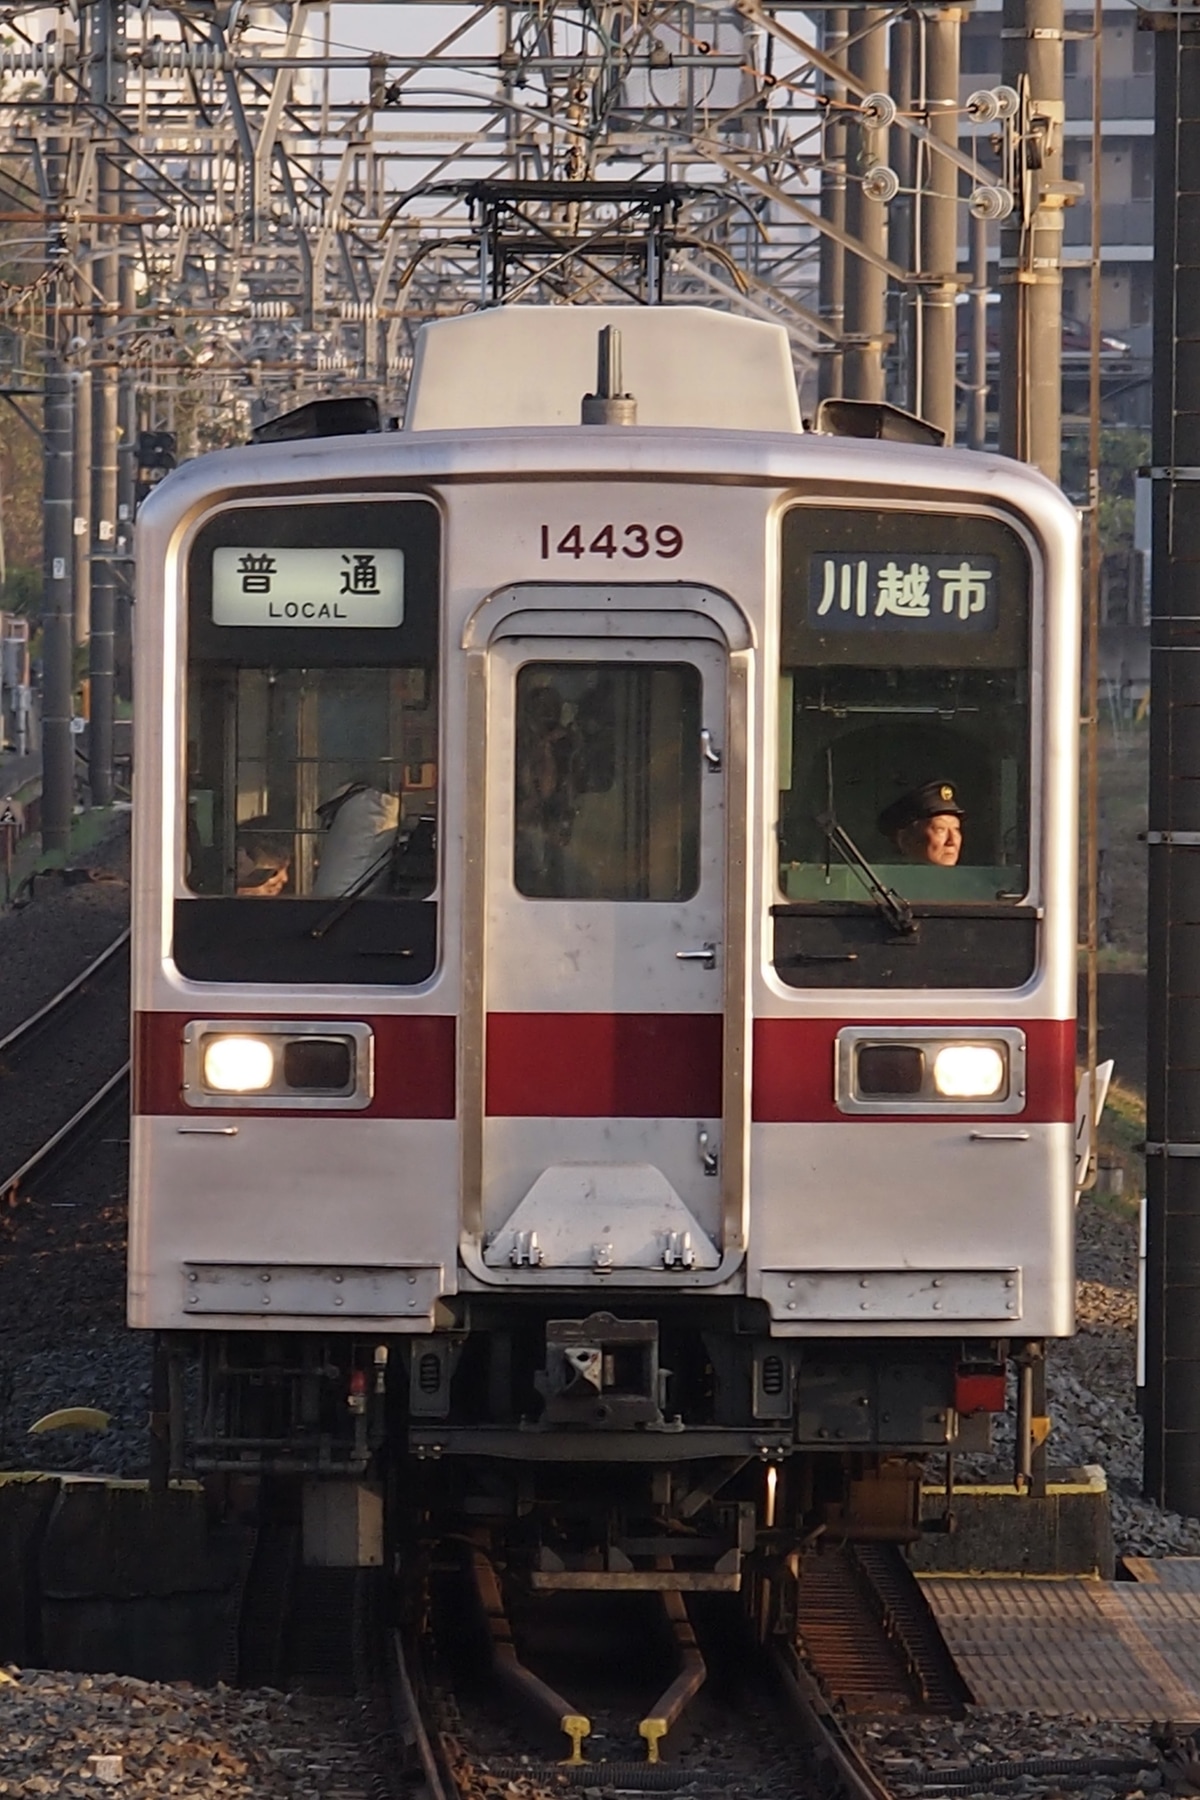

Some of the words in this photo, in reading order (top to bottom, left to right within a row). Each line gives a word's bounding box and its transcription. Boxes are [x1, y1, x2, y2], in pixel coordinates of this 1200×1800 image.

[541, 524, 683, 559] 14439
[236, 553, 380, 595] 普通
[817, 560, 992, 620] 川越市
[269, 602, 347, 618] LOCAL
